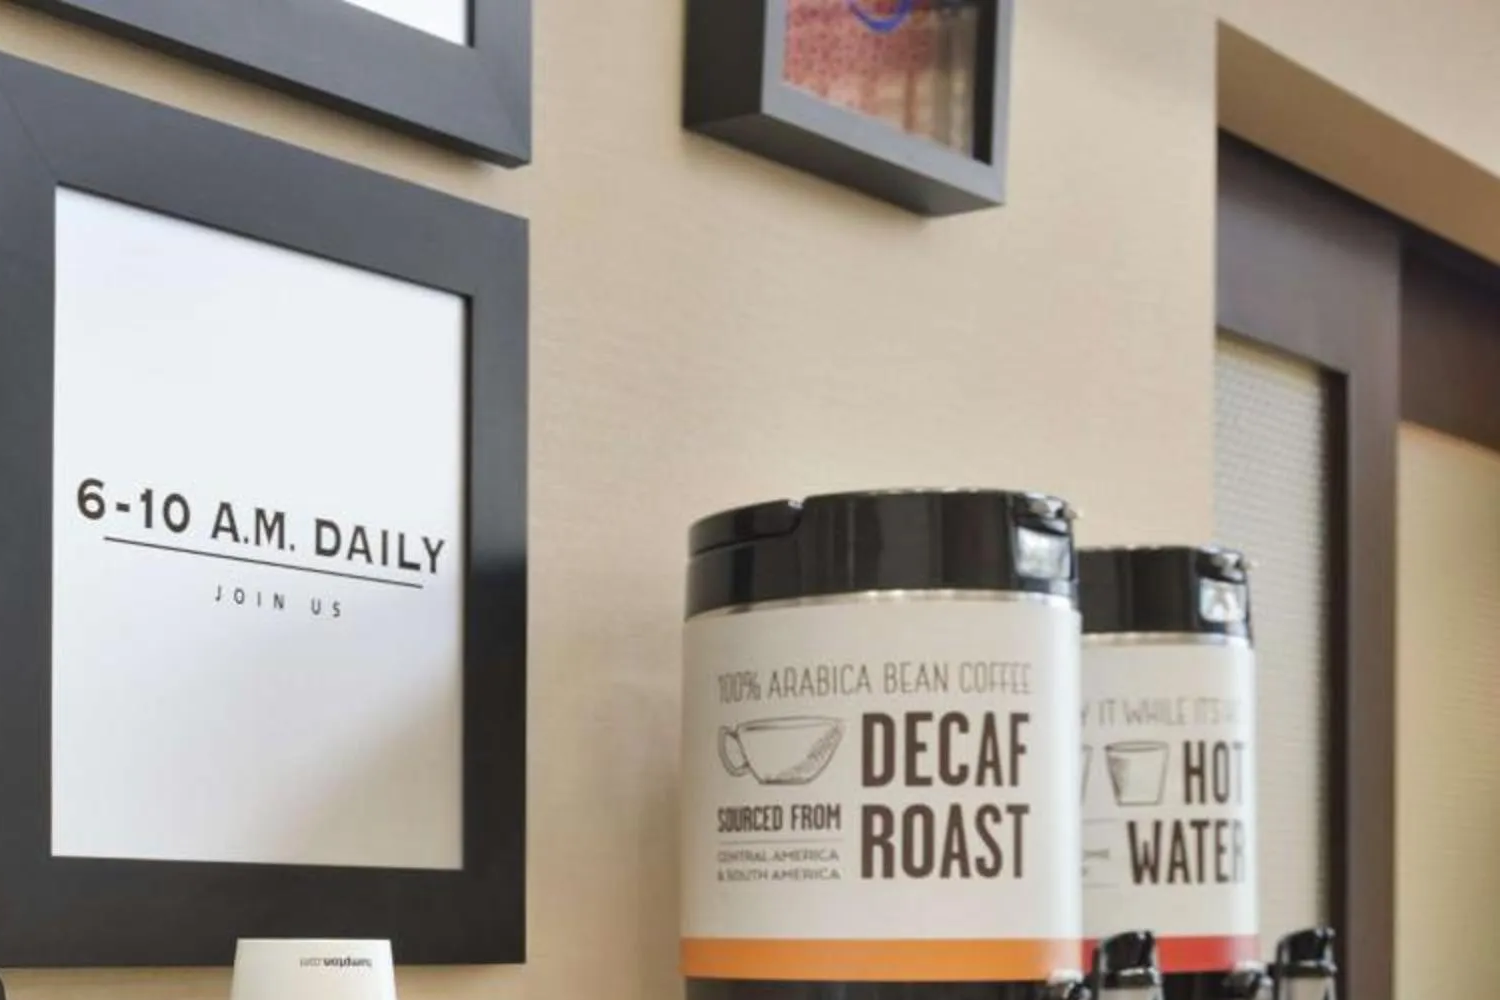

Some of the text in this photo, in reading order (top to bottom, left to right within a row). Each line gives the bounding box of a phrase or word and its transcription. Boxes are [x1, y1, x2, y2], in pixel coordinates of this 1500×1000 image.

[77, 477, 445, 574] 6-10 A.M. DAILY
[215, 585, 342, 618] JOIN US
[717, 661, 1032, 703] 100% ARABICA BEAN COFFEE
[861, 711, 1031, 788] DECAF
[1183, 740, 1245, 804] HOT
[717, 802, 842, 833] SOURCED FROM
[860, 802, 1031, 880] ROAST
[1127, 818, 1246, 885] WATER
